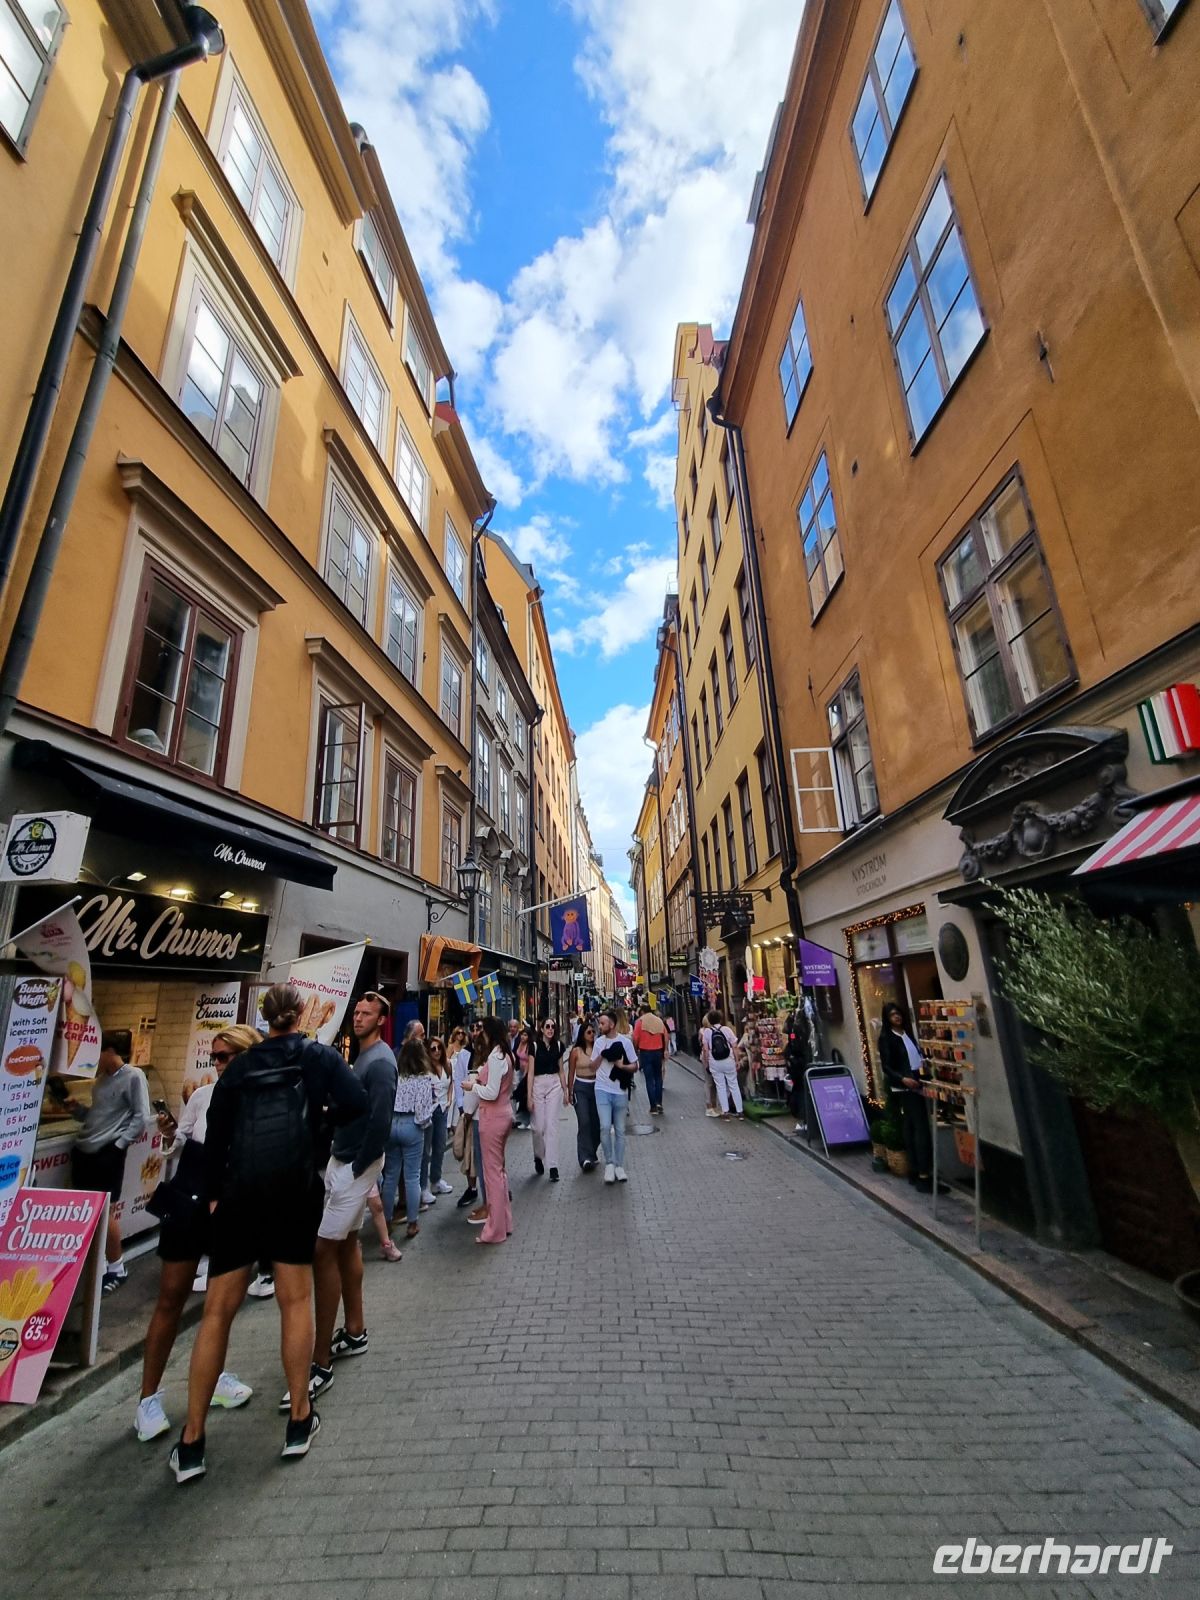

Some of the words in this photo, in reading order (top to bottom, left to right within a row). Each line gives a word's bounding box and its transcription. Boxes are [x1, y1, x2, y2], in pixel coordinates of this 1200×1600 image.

[213, 843, 234, 862] Mr.
[234, 849, 266, 871] Churros
[77, 894, 138, 957] Mr.
[139, 905, 242, 960] Churros
[19, 983, 50, 994] Bubble
[288, 976, 317, 991] Spanish
[318, 984, 347, 998] Churros
[18, 993, 49, 1006] Waffle
[196, 992, 237, 1006] Spanish
[196, 1006, 234, 1020] Churros
[12, 1019, 31, 1027] with
[31, 1017, 47, 1026] Soft
[59, 1020, 96, 1034] WEDISH
[9, 1027, 48, 1037] icecream
[64, 1031, 98, 1044] CREAM
[28, 1037, 37, 1045] kr
[8, 1055, 41, 1064] IceCream
[195, 1059, 215, 1070] bak
[7, 1081, 25, 1091] (one)
[10, 1092, 21, 1101] 35
[22, 1091, 31, 1099] kr
[4, 1103, 22, 1115] (two)
[23, 1100, 38, 1110] ball
[6, 1115, 17, 1126] 65
[18, 1114, 27, 1124] kr
[0, 1128, 20, 1139] three)
[21, 1123, 37, 1134] ball
[1, 1141, 12, 1151] 80
[14, 1139, 23, 1148] kr
[7, 1160, 20, 1170] ice
[32, 1152, 70, 1173] SWED
[133, 1193, 151, 1205] SPAN
[16, 1198, 94, 1224] Spanish
[7, 1223, 84, 1251] Churros
[29, 1315, 52, 1326] ONLY
[24, 1324, 43, 1341] 65
